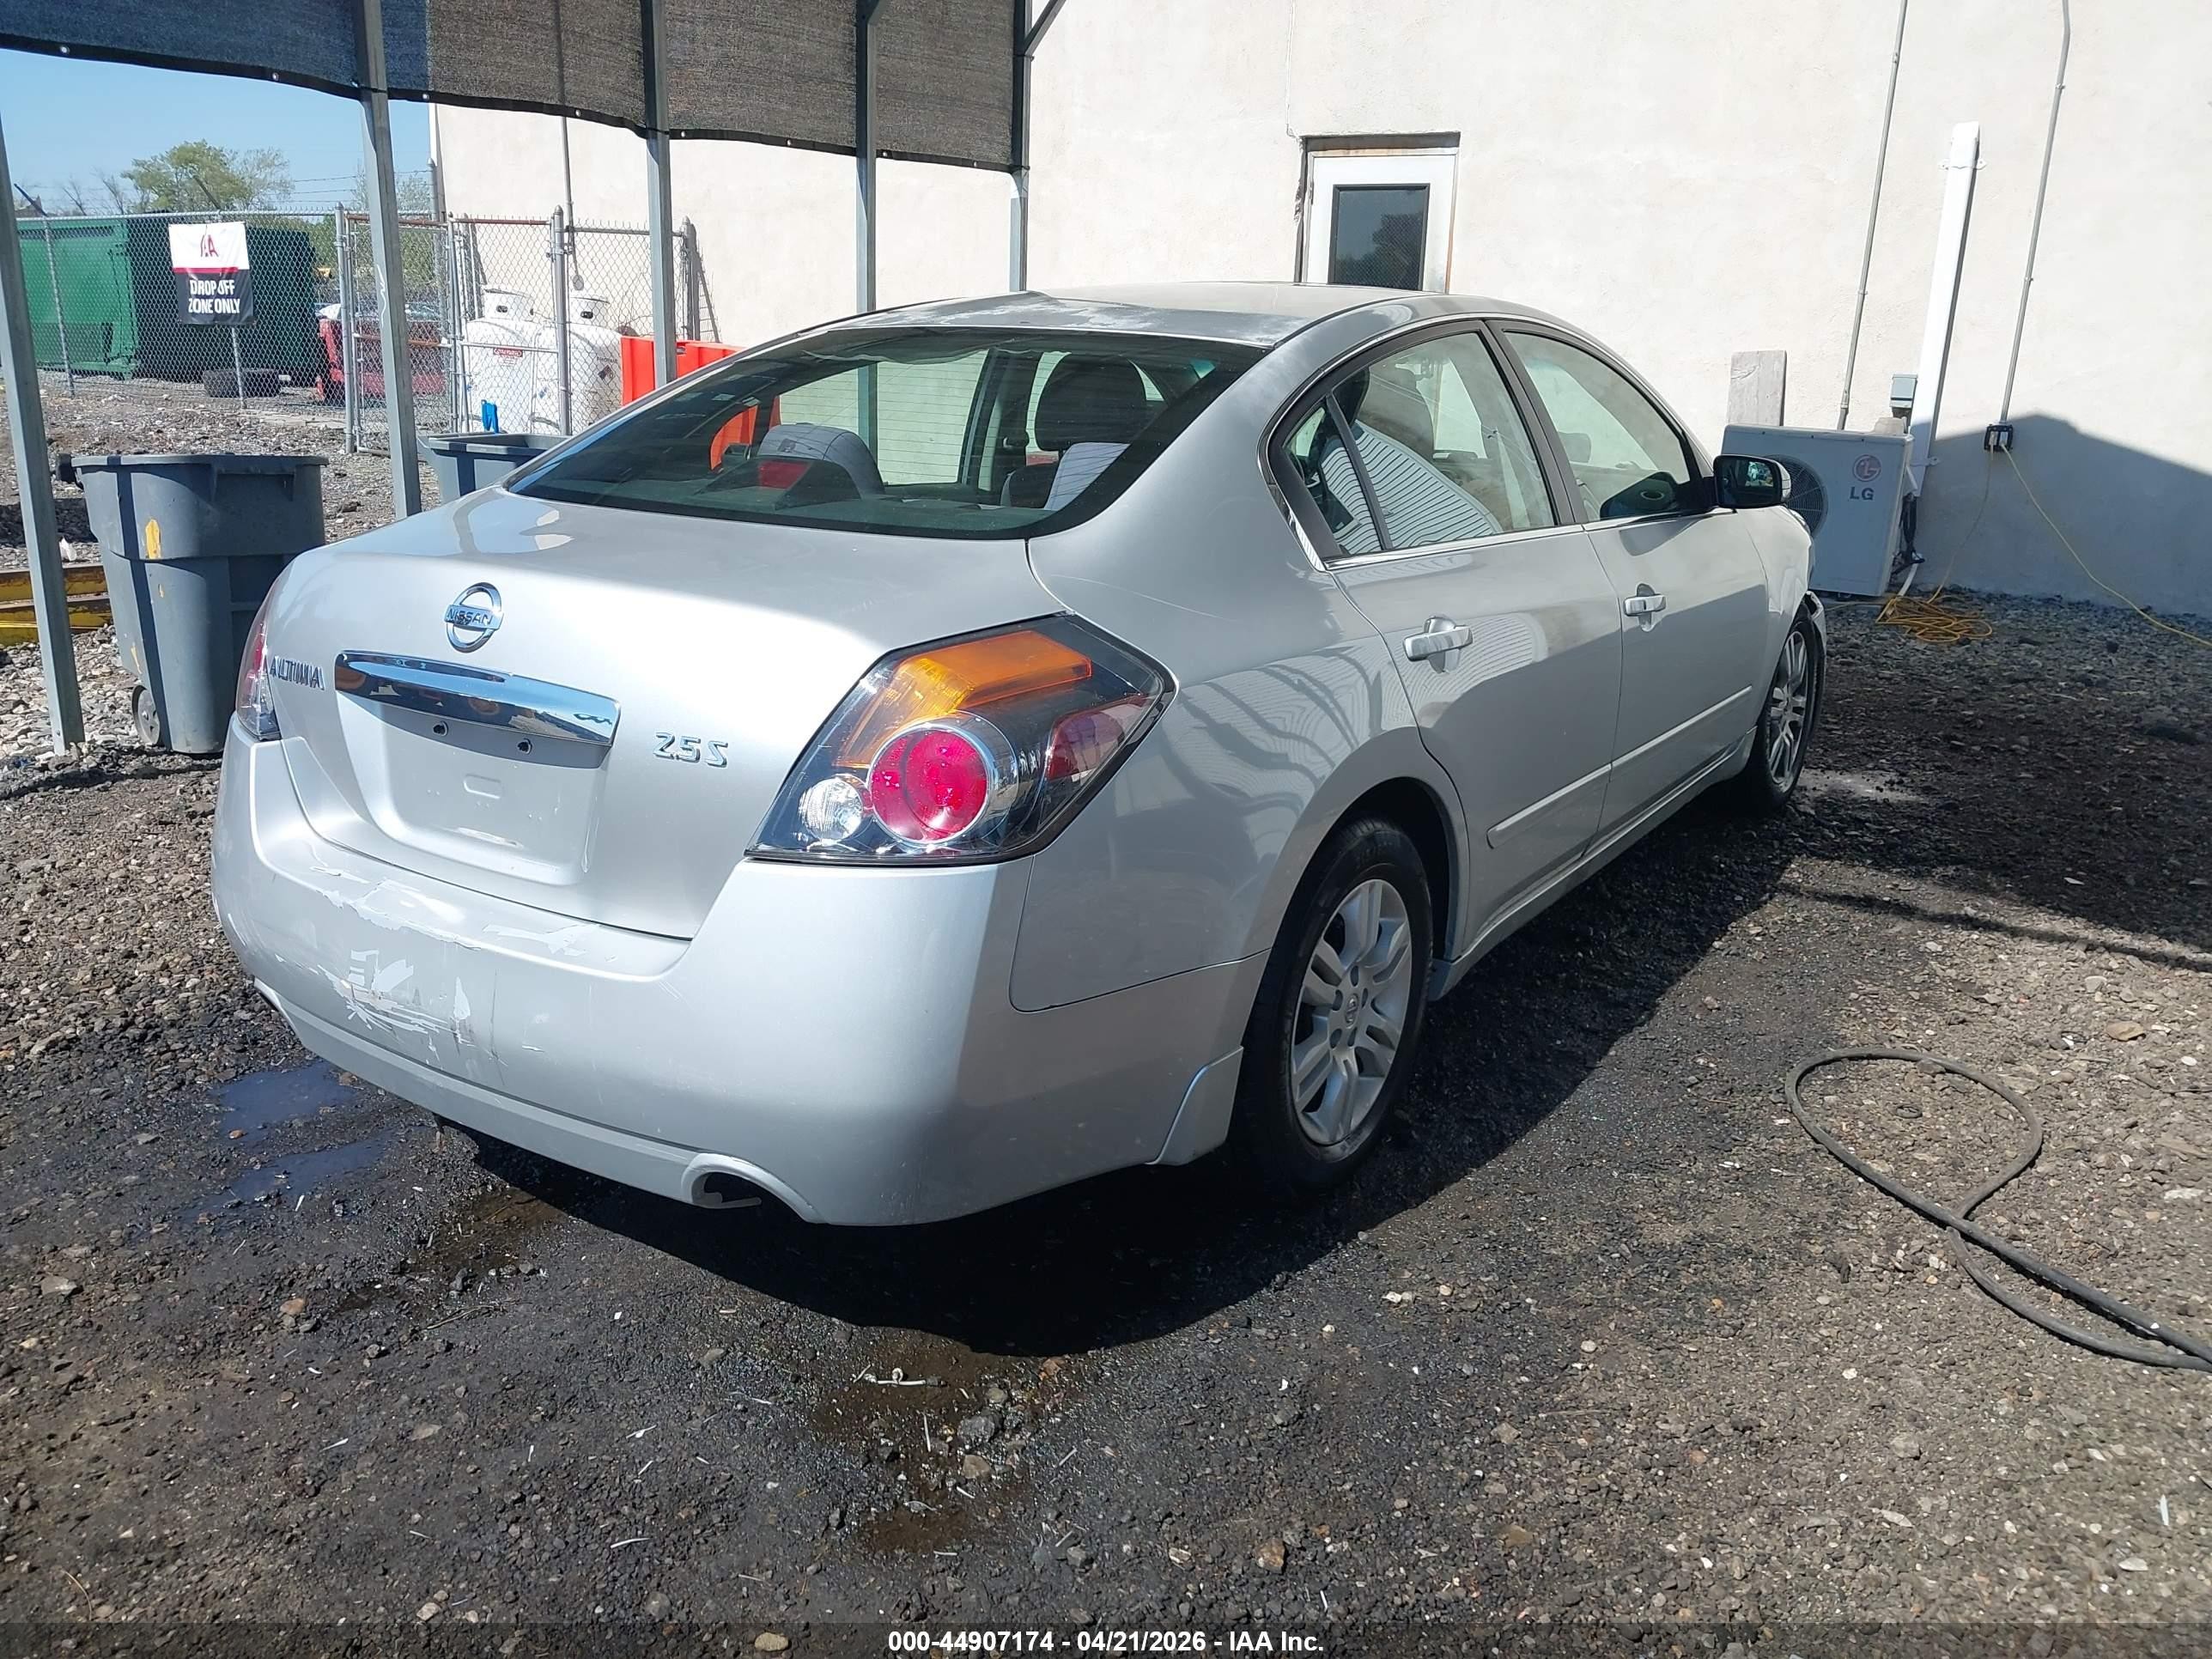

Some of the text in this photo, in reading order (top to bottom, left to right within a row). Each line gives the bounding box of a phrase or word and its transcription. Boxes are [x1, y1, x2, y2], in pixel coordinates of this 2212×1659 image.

[190, 279, 235, 295] DROP OFF
[188, 298, 240, 313] ZONE ONLY
[1849, 486, 1875, 501] LG
[447, 608, 495, 626] NISSAN
[270, 656, 325, 691] ALTIMA
[704, 739, 729, 769] S
